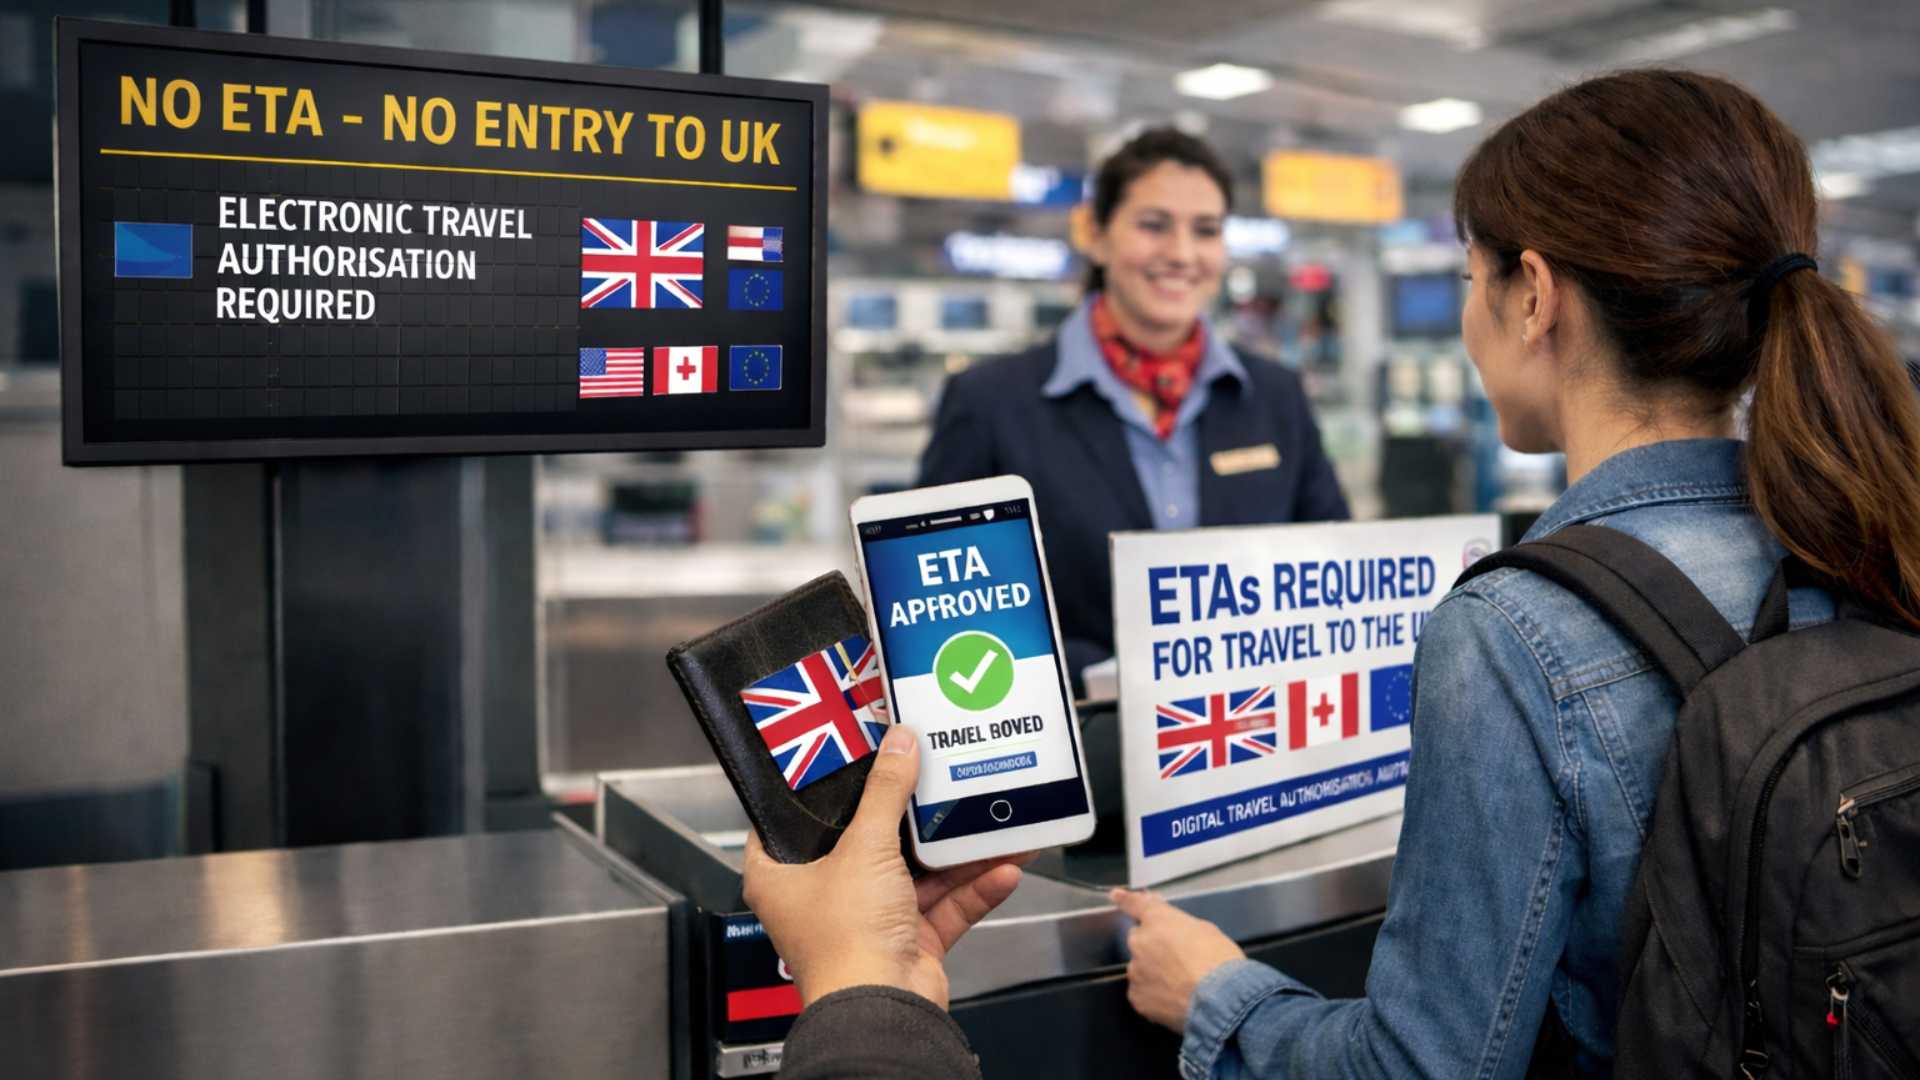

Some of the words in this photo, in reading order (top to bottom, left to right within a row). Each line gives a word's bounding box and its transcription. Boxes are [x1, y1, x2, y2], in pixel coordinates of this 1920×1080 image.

[120, 75, 201, 129] NO
[222, 84, 323, 137] ETA
[342, 115, 363, 123] -
[383, 95, 456, 146] NO
[475, 101, 633, 155] ENTRY
[647, 112, 706, 160] TO
[721, 119, 781, 166] UK
[219, 196, 413, 235] ELECTRONIC
[422, 205, 533, 239] TRAVEL
[217, 243, 476, 280] AUTHORISATION
[217, 287, 376, 322] REQUIRED
[917, 546, 991, 586] ETA
[1148, 564, 1260, 625] ETAs
[1274, 556, 1436, 611] REQUIRED
[1153, 637, 1213, 680] FOR
[1221, 623, 1321, 670] TRAVEL
[1326, 620, 1356, 653] TO
[1362, 614, 1404, 649] THE
[1172, 812, 1225, 837] DIGITAL
[1228, 796, 1278, 823] TRAVEL
